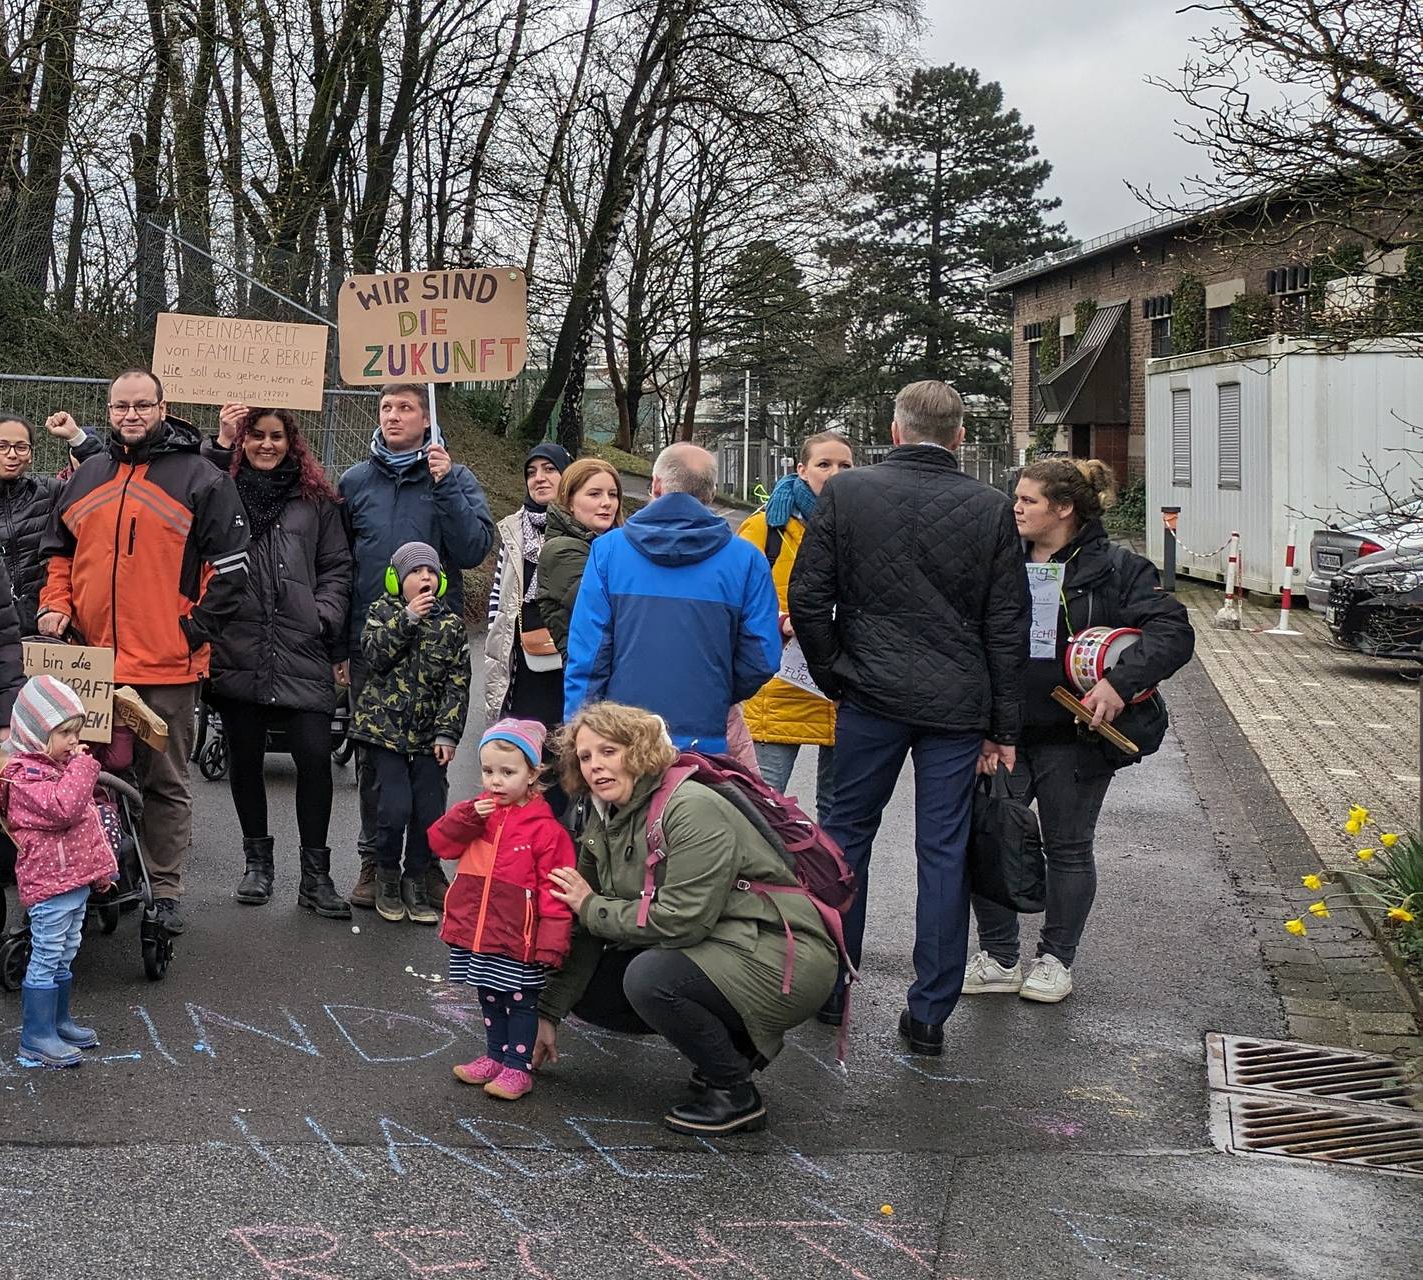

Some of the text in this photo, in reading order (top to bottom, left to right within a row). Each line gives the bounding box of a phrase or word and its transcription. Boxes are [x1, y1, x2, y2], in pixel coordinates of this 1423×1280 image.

[356, 273, 498, 311] WIR SIND
[172, 319, 299, 346] VEREINBARKEIT
[398, 308, 448, 337] DIE
[165, 342, 319, 367] von FAMILIE & BERUF
[362, 337, 521, 377] ZUKUNFT
[163, 363, 181, 376] Wie
[191, 365, 208, 377] soll
[214, 367, 230, 379] das
[271, 375, 295, 384] wenn
[300, 375, 314, 387] die
[193, 384, 220, 397] wieder
[43, 648, 63, 670] bin
[71, 652, 92, 670] die
